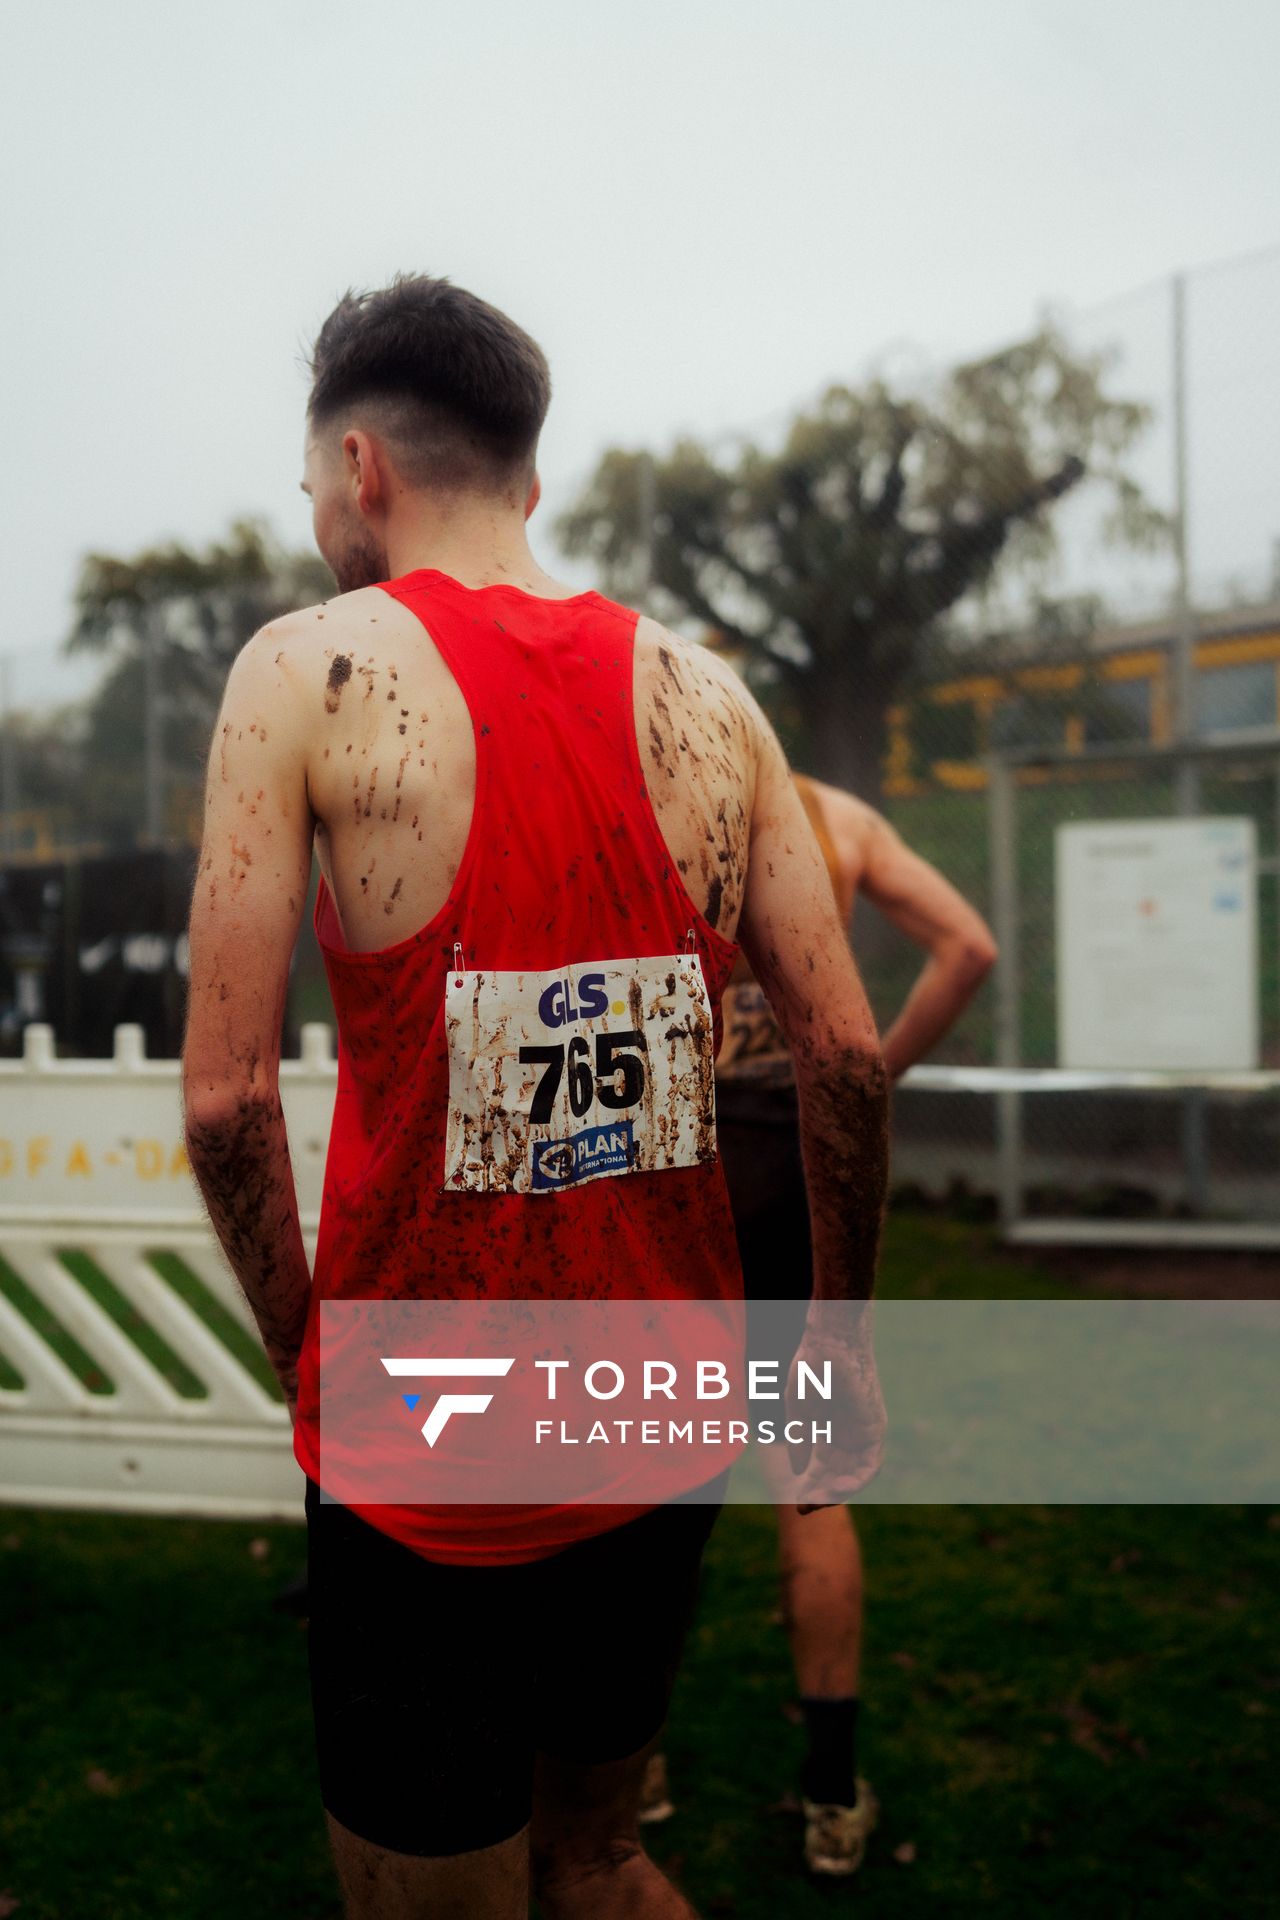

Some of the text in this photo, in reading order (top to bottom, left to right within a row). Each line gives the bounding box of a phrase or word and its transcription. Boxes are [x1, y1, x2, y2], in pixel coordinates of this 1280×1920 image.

[519, 1029, 648, 1124] 765
[577, 1130, 628, 1162] PLAN
[579, 1154, 628, 1173] TERNATIONAL
